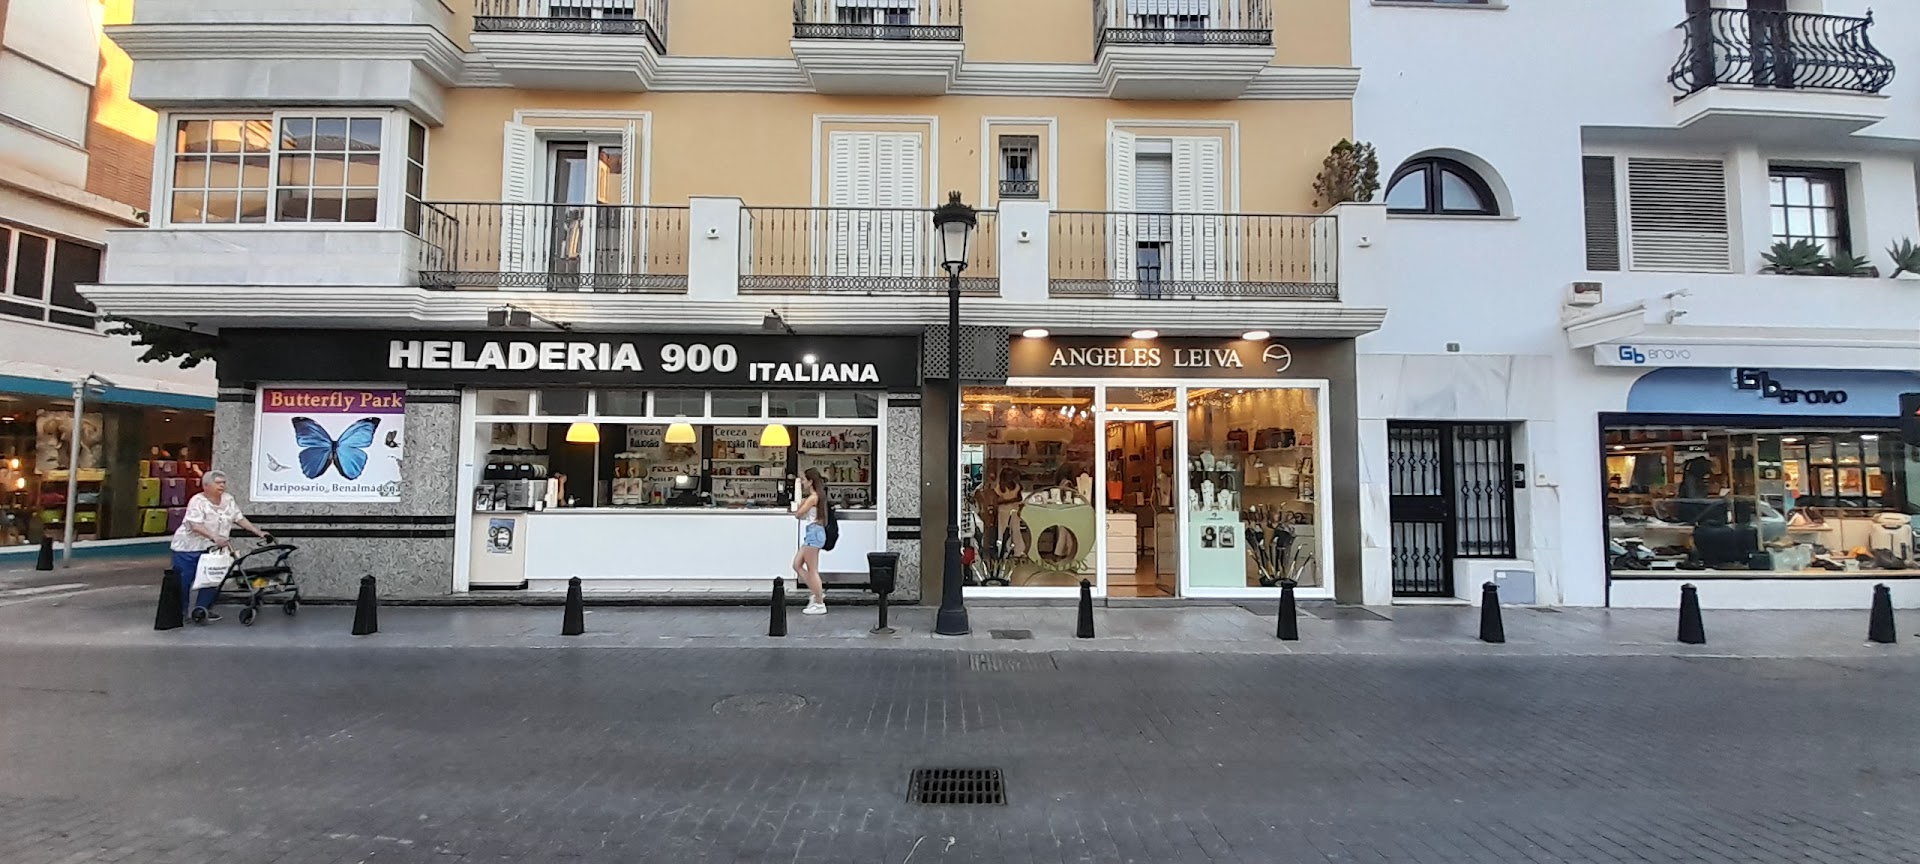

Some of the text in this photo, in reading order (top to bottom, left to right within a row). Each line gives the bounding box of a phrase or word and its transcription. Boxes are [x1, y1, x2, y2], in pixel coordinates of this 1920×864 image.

[388, 340, 738, 372] HELADERIA 900
[1049, 348, 1243, 368] ANGELES LEIVA
[749, 362, 879, 382] ITALIANA
[270, 391, 402, 411] Butterfly Park
[628, 427, 661, 436] Cereza
[714, 427, 747, 437] Cereza
[799, 428, 832, 437] Cereza
[262, 482, 325, 494] Mariposario
